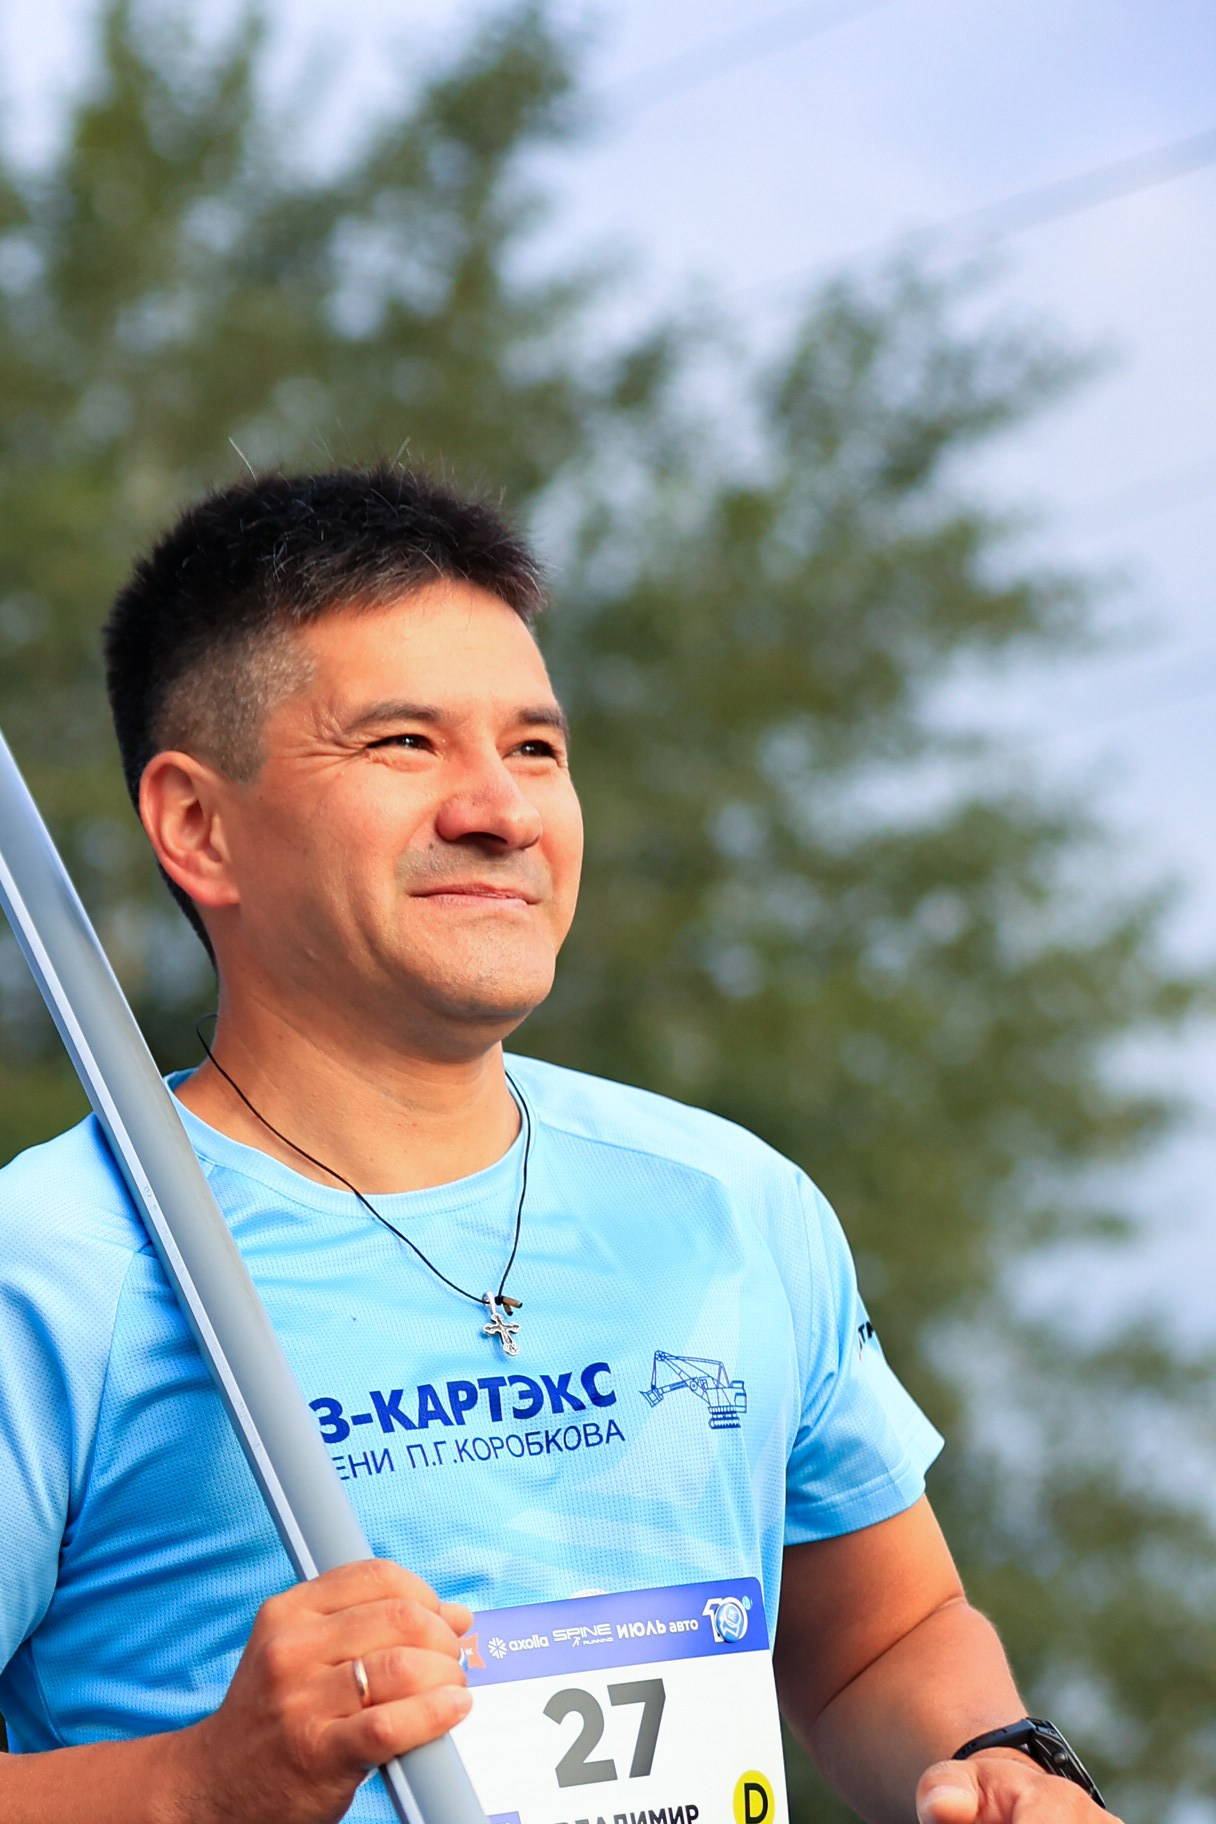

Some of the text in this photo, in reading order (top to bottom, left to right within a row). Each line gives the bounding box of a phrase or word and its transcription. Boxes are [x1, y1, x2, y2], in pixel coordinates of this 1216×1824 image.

[308, 1361, 617, 1445] З-КАРТЭКС
[331, 1447, 395, 1481] ЕНИ
[508, 1634, 550, 1652] axolla
[552, 1623, 612, 1642] SPINE
[616, 1619, 699, 1639] ИЮЛЬ авто
[542, 1678, 666, 1788] 27
[743, 1782, 768, 1824] D
